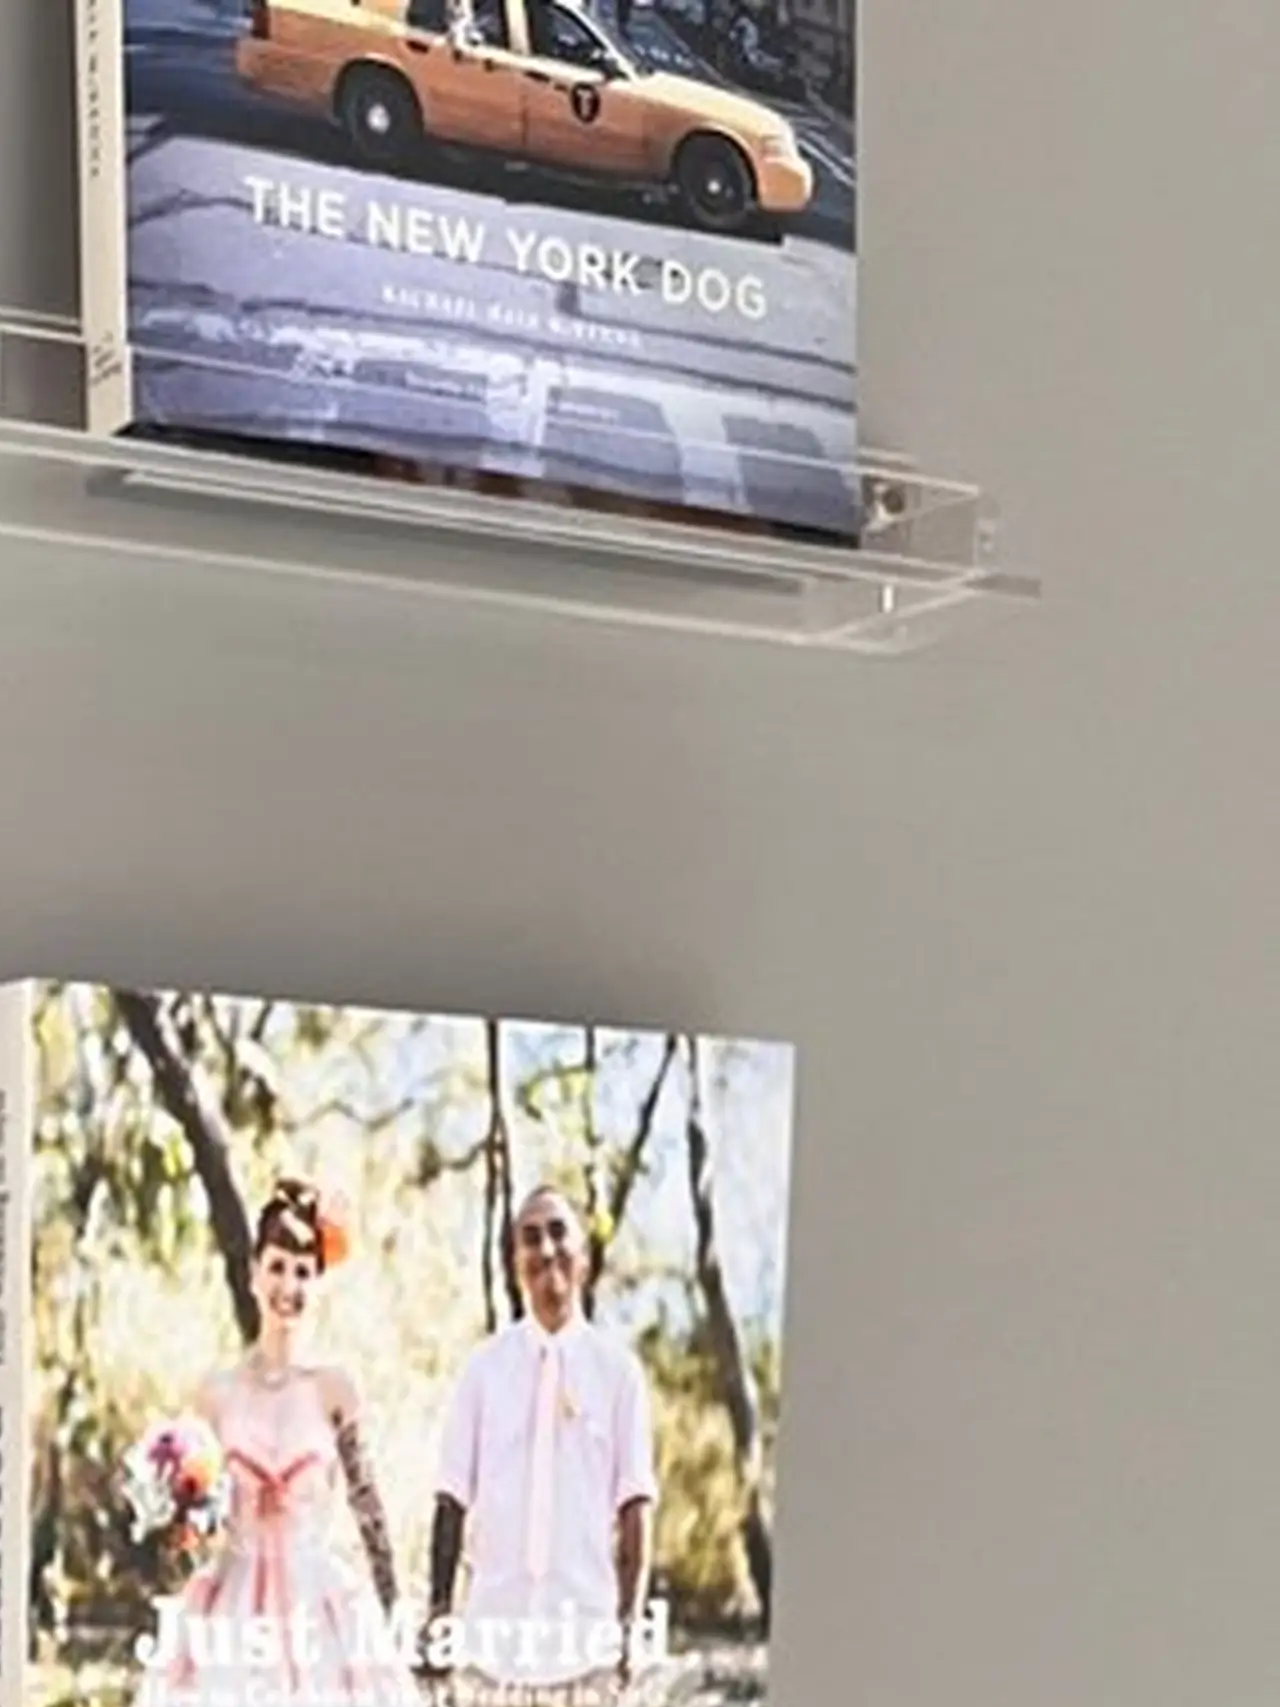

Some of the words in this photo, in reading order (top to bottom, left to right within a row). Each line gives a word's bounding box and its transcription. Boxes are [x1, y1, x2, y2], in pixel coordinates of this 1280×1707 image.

[244, 175, 347, 237] THE
[367, 199, 485, 263] NEW
[506, 229, 642, 297] YORK
[661, 259, 767, 319] DOG
[134, 1595, 323, 1669] Just
[346, 1597, 671, 1670] Married
